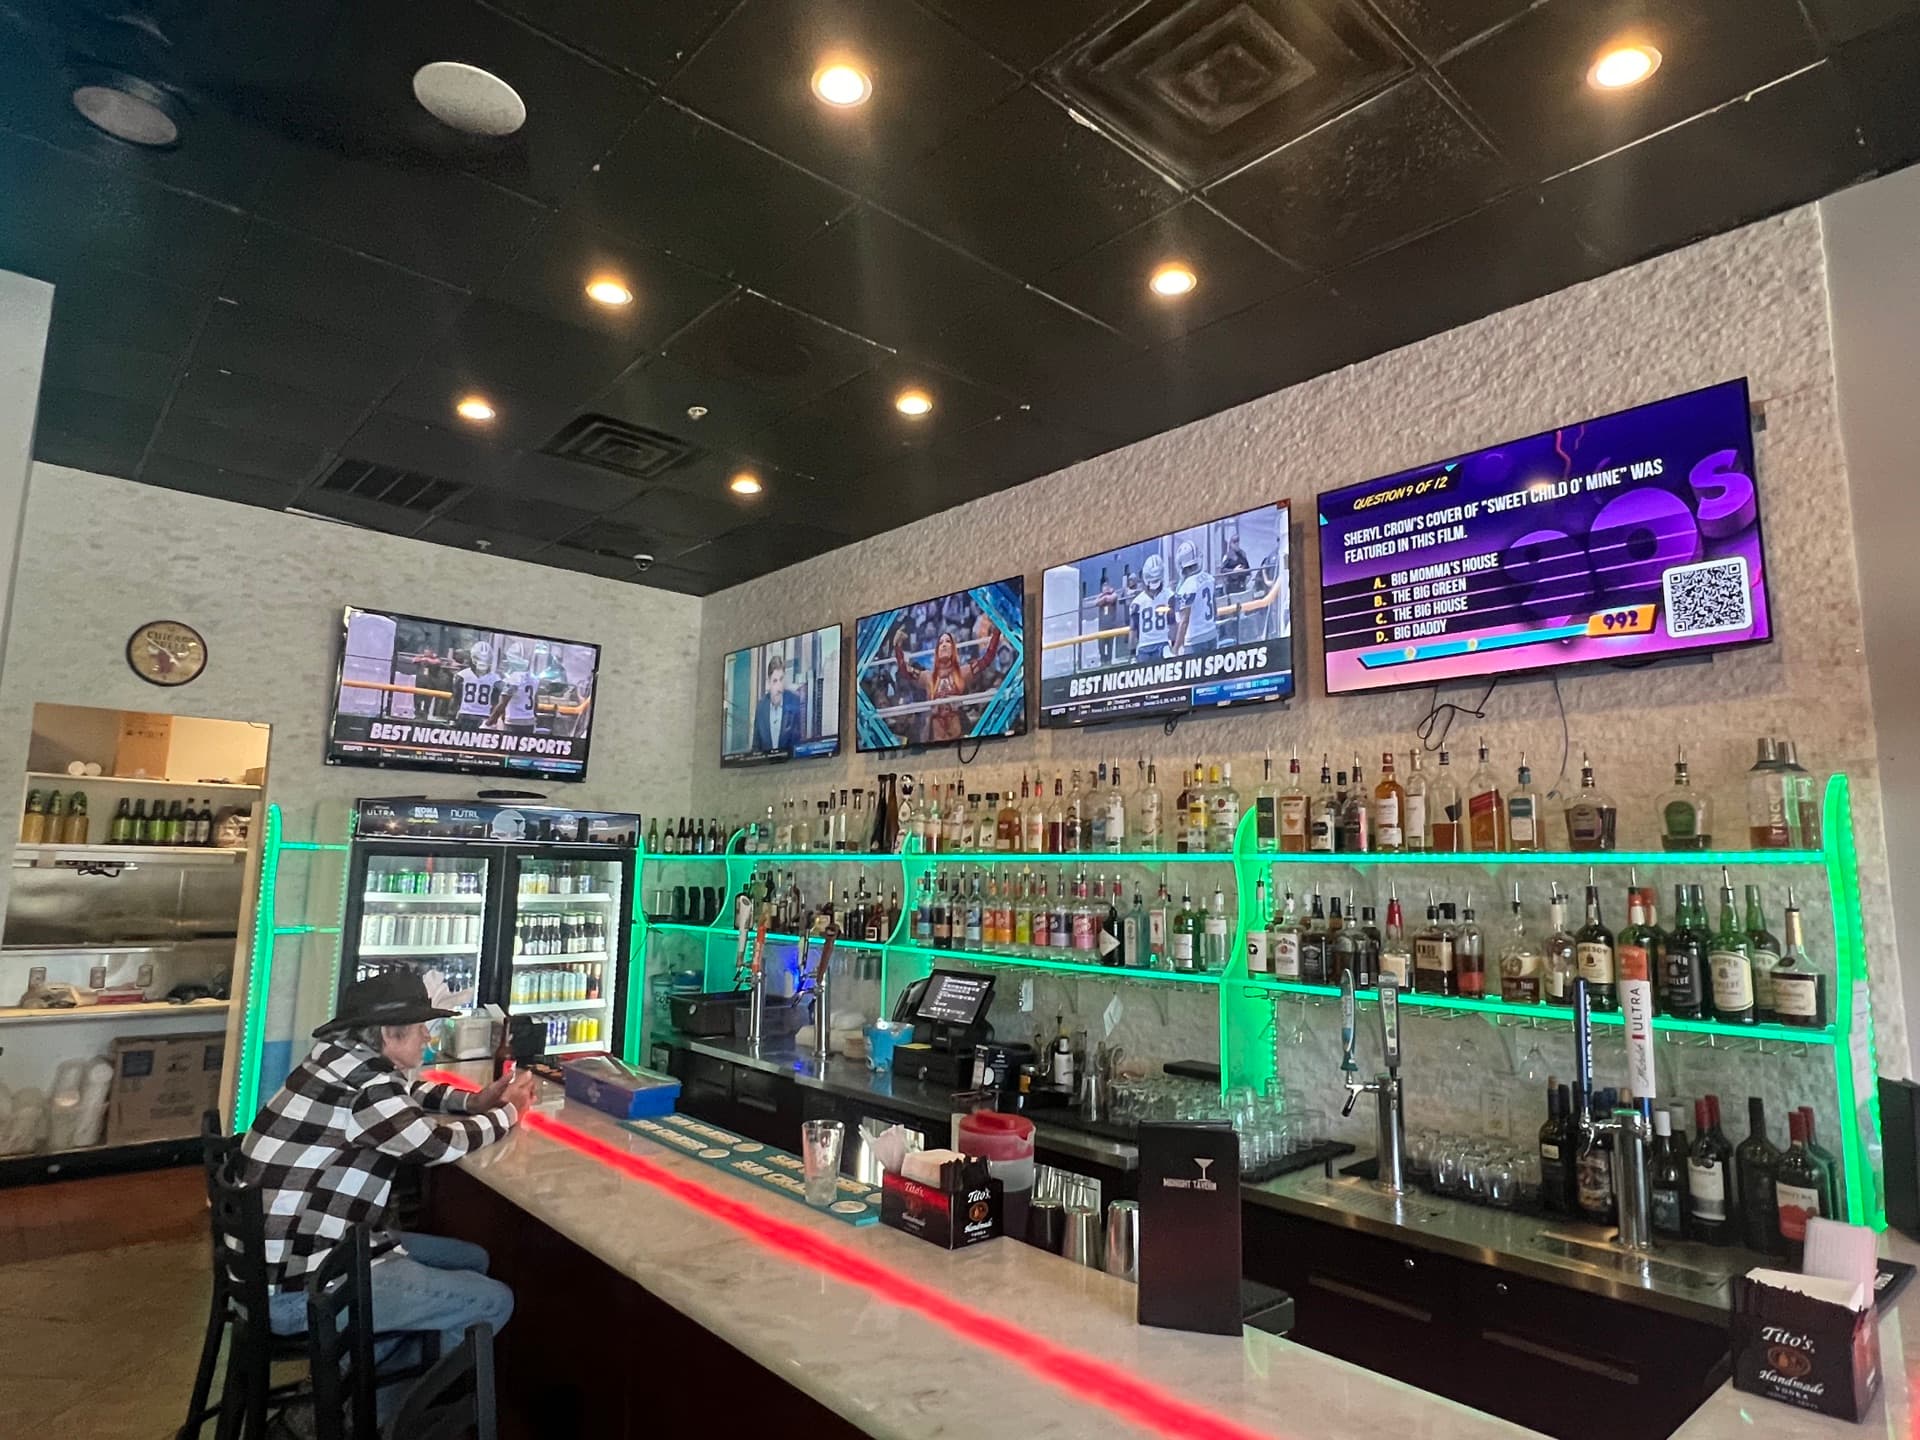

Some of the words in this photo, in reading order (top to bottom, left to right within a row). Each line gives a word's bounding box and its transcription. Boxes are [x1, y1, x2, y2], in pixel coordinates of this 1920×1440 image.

[1343, 528, 1383, 547] SHERYL
[1384, 516, 1424, 538] CROW'S
[1426, 506, 1462, 532] COVER
[1464, 502, 1479, 518] OF
[1481, 490, 1529, 514] "SWEET
[1530, 481, 1568, 504] CHILD
[1570, 477, 1583, 494] O'
[1586, 466, 1627, 491] MINE"
[1630, 458, 1664, 481] WAS
[1353, 488, 1406, 510] QUESTION
[1406, 485, 1414, 496] 9
[1415, 479, 1433, 494] OF
[1434, 476, 1448, 490] 12
[1344, 538, 1396, 564] FEATURED
[1397, 536, 1409, 552] IN
[1410, 531, 1435, 550] THIS
[1437, 525, 1468, 544] FILM.
[1373, 577, 1387, 590] A.
[1391, 571, 1408, 587] BIG
[1409, 560, 1461, 583] MOMMA'S
[1462, 552, 1499, 571] HOUSE
[1202, 587, 1213, 620] 3
[1373, 595, 1387, 607] B.
[1392, 588, 1413, 604] THE
[1413, 584, 1431, 601] BIG
[1432, 577, 1467, 596] GREEN
[1141, 607, 1166, 633] 88
[1375, 612, 1388, 625] C.
[1393, 606, 1413, 622] THE
[1414, 602, 1432, 618] BIG
[1433, 596, 1468, 615] HOUSE
[1603, 610, 1638, 630] 992
[1375, 631, 1389, 643] D.
[1394, 625, 1412, 640] BIG
[1412, 619, 1447, 638] DADDY
[1070, 678, 1102, 698] BEST
[1102, 661, 1183, 692] NICKNAMES
[1185, 657, 1202, 680] IN
[1205, 646, 1268, 676] SPORTS
[464, 682, 491, 706] 88
[524, 685, 534, 711] 3
[370, 722, 412, 742] BEST
[413, 727, 499, 750] NICKNAMES
[500, 735, 518, 751] IN
[518, 737, 573, 756] SPORTS
[366, 809, 395, 817] ULTRA
[1630, 987, 1643, 1031] ULTRA
[967, 1187, 991, 1203] Tito's
[1762, 1326, 1815, 1352] Tito's
[1759, 1369, 1825, 1395] Handmade
